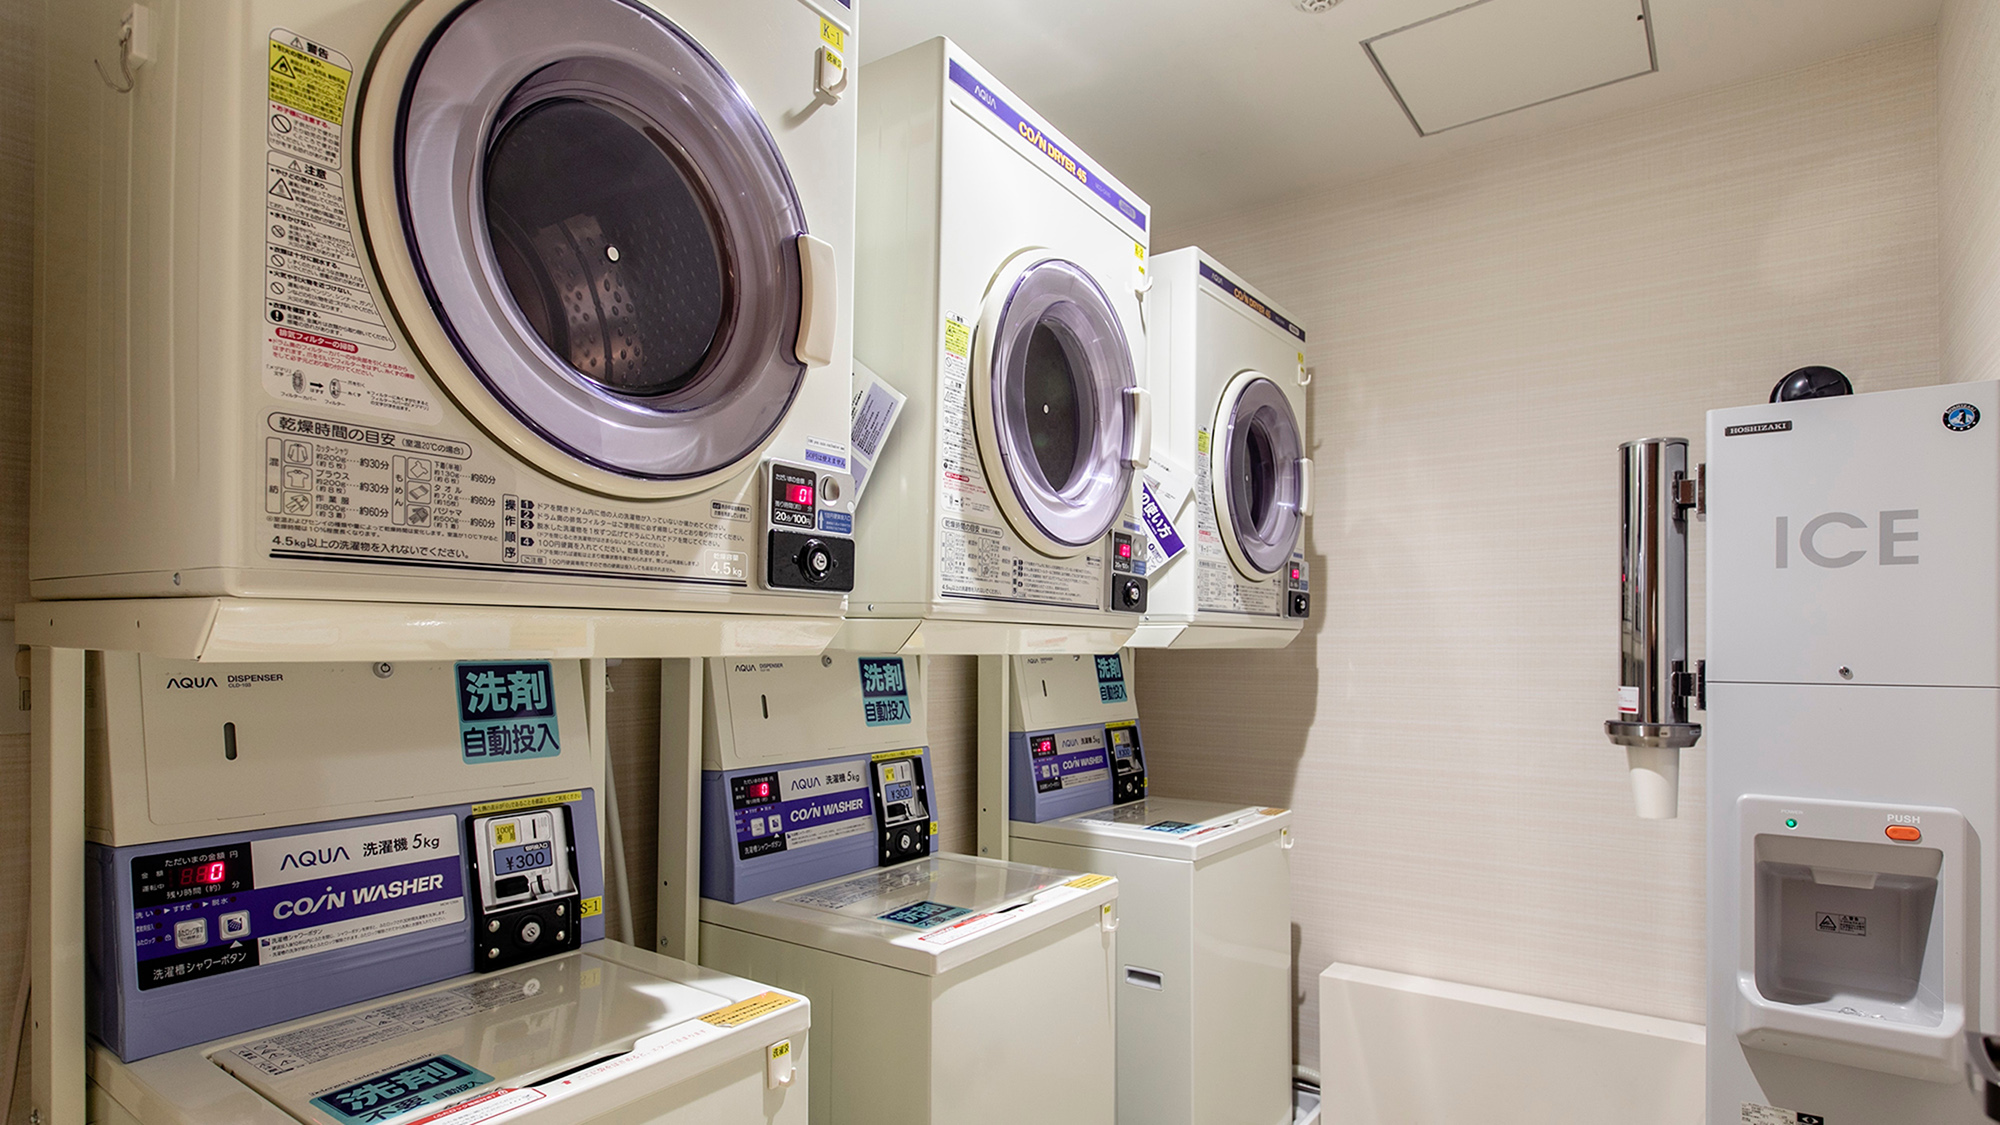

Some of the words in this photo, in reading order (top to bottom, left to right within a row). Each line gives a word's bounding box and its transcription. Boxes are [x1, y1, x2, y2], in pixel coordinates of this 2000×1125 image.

[823, 23, 840, 46] K-1
[306, 42, 329, 60] 警告
[974, 85, 997, 110] AQUA
[277, 105, 331, 130] お子様に注意する。
[304, 164, 327, 180] 注意
[1047, 143, 1076, 175] DRYER
[1076, 167, 1088, 184] 45
[278, 328, 356, 352] 排気フィルターの掃除
[279, 416, 396, 447] 乾燥時間の目安
[1730, 422, 1787, 435] HOSHIZAKI
[360, 457, 389, 471] 約30分
[316, 469, 350, 480] ブラウス
[359, 482, 389, 494] 約30分
[394, 474, 404, 507] もめん
[799, 488, 807, 502] 0
[359, 506, 389, 518] 約60分
[504, 499, 516, 559] 操作順序
[272, 535, 469, 559] 4.5kg以上の洗濯物を入れないでください。
[1775, 508, 1919, 569] ICE
[735, 664, 757, 672] AQUA
[1097, 657, 1122, 679] 洗剤
[166, 677, 219, 689] AQUA
[227, 673, 284, 683] DISPENSER
[863, 663, 904, 693] 洗剤
[465, 670, 548, 713] 洗剤
[1100, 684, 1127, 700] 自動投入
[865, 700, 911, 723] 自動投入
[463, 723, 560, 758] 自動投入
[1062, 739, 1079, 748] AQUA
[1080, 755, 1103, 767] WASHER
[761, 783, 768, 795] 0
[791, 777, 821, 791] AQUA
[825, 773, 846, 785] 洗濯機
[847, 771, 860, 782] 5kg
[891, 788, 909, 800] ¥300
[823, 799, 863, 816] WASHER
[1887, 813, 1921, 824] PUSH
[164, 852, 226, 868] ただいまの金額
[229, 850, 239, 859] 円
[280, 846, 350, 871] AQUA
[362, 837, 408, 857] 洗濯機
[412, 833, 440, 850] 5kg
[505, 851, 545, 871] ¥300
[210, 863, 223, 881] 0
[142, 883, 165, 893] 運転中
[231, 880, 240, 889] 分
[352, 873, 444, 906] WASHER
[173, 903, 192, 913] すすぎ
[211, 898, 228, 906] 脱水
[580, 901, 600, 914] S-1
[135, 910, 154, 919] 洗い
[153, 952, 247, 981] 洗濯槽シャワーボタン
[335, 1061, 457, 1111] 洗剤
[359, 1095, 430, 1123] 不要
